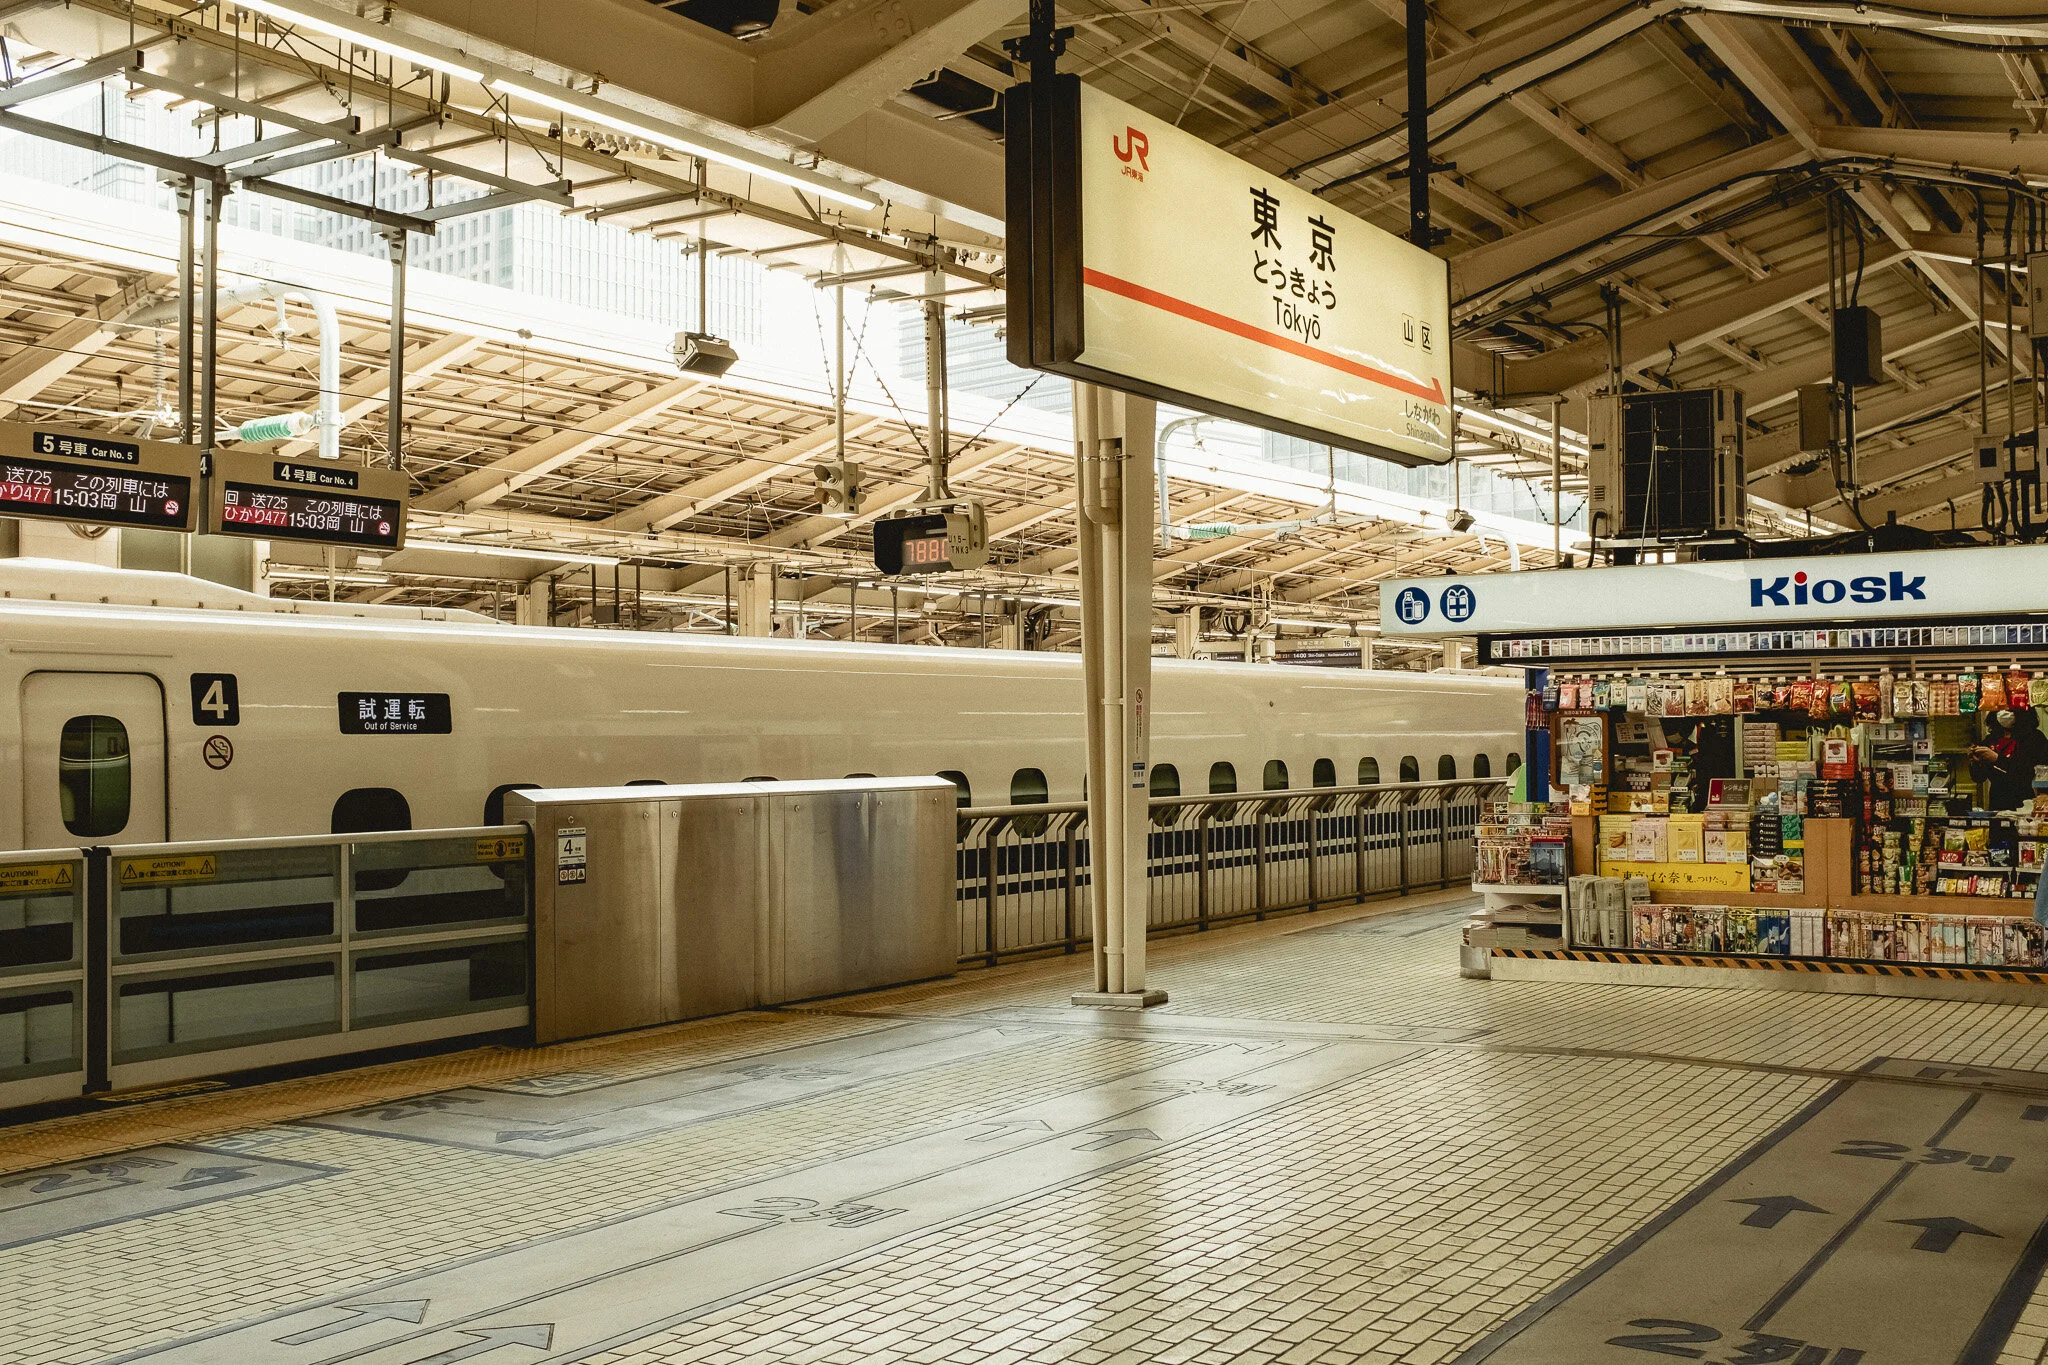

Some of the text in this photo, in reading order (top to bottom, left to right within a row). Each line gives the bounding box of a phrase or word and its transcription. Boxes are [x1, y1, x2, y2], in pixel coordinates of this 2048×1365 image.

[1113, 126, 1149, 172] JR
[1121, 165, 1144, 183] JR東海
[1253, 249, 1337, 310] とうきょう
[1273, 295, 1321, 344] Tōkyō
[1406, 400, 1441, 426] しながわ
[91, 447, 108, 457] Car
[109, 450, 125, 460] No.
[127, 451, 133, 461] 5
[74, 474, 169, 499] この列車には
[319, 474, 333, 484] Car
[334, 476, 347, 486] No.
[348, 478, 353, 486] 4
[54, 489, 99, 509] 15:03
[305, 499, 382, 520] この列車には
[289, 512, 326, 529] 15:03
[951, 545, 969, 554] TNK3
[1750, 571, 1927, 608] Kiosk
[1344, 640, 1351, 648] 16
[201, 680, 229, 719] 4
[358, 698, 426, 720] 試運転
[364, 721, 418, 731] Out of Service
[563, 838, 574, 855] 4
[0, 870, 39, 879] CAUTION!!
